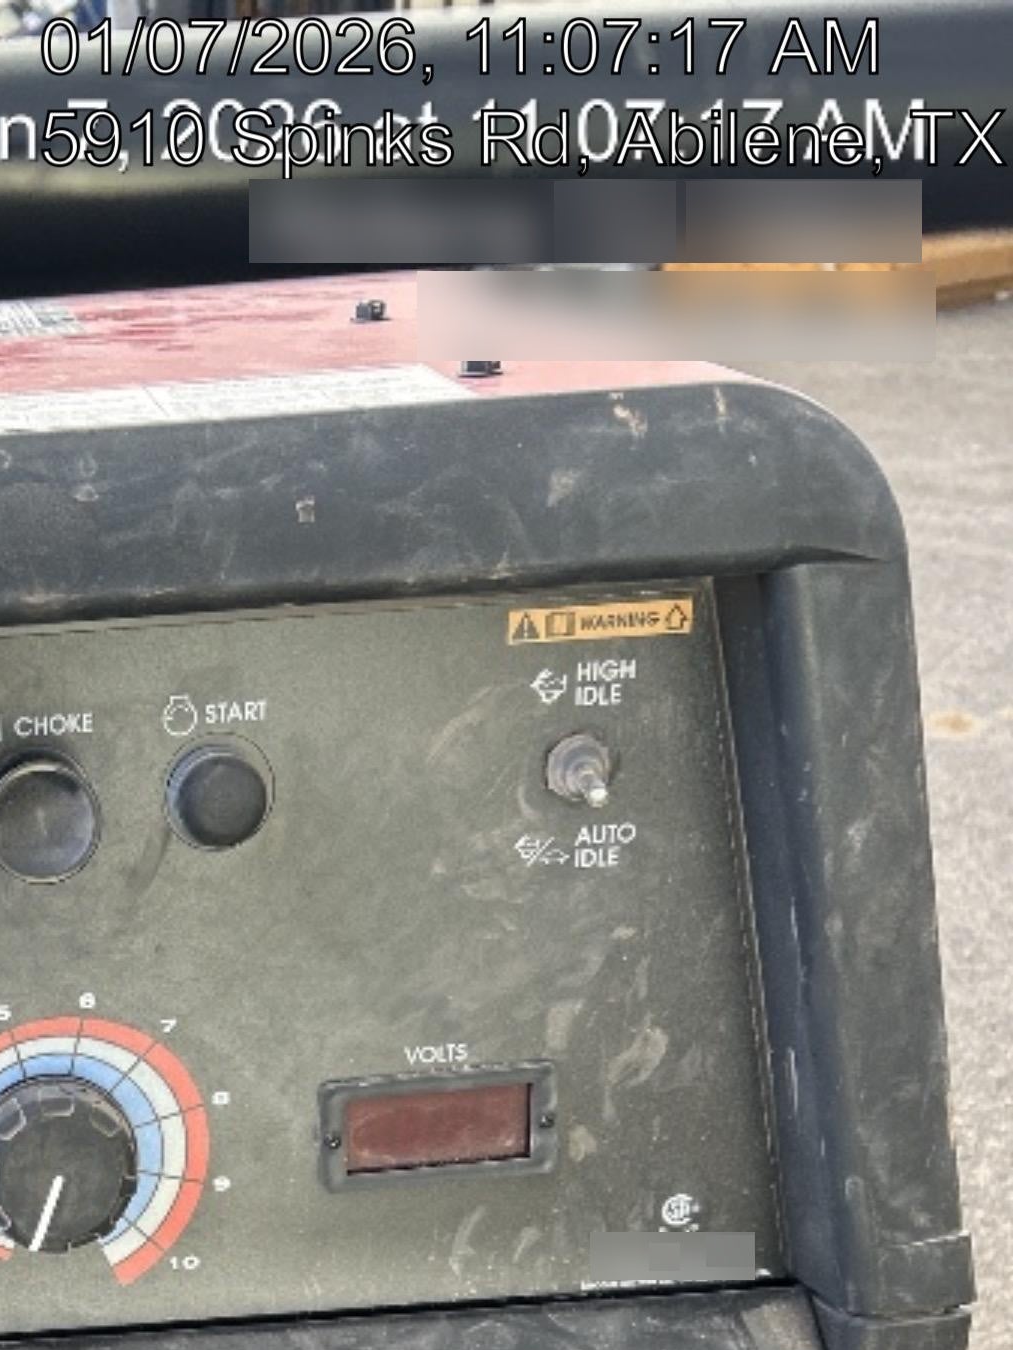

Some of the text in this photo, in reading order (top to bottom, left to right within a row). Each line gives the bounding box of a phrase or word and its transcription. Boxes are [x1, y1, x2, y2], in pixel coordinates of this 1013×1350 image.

[580, 611, 661, 631] WARNING
[576, 659, 637, 683] HIGH
[574, 684, 623, 706] IDLE
[204, 700, 268, 724] START
[13, 713, 94, 738] CHOKE
[574, 822, 637, 846] AUTO
[574, 847, 622, 868] IDLE
[78, 992, 97, 1010] 6
[160, 1018, 178, 1034] 7
[404, 1043, 469, 1066] VOLTS
[212, 1177, 232, 1193] 9
[170, 1255, 201, 1271] 10
